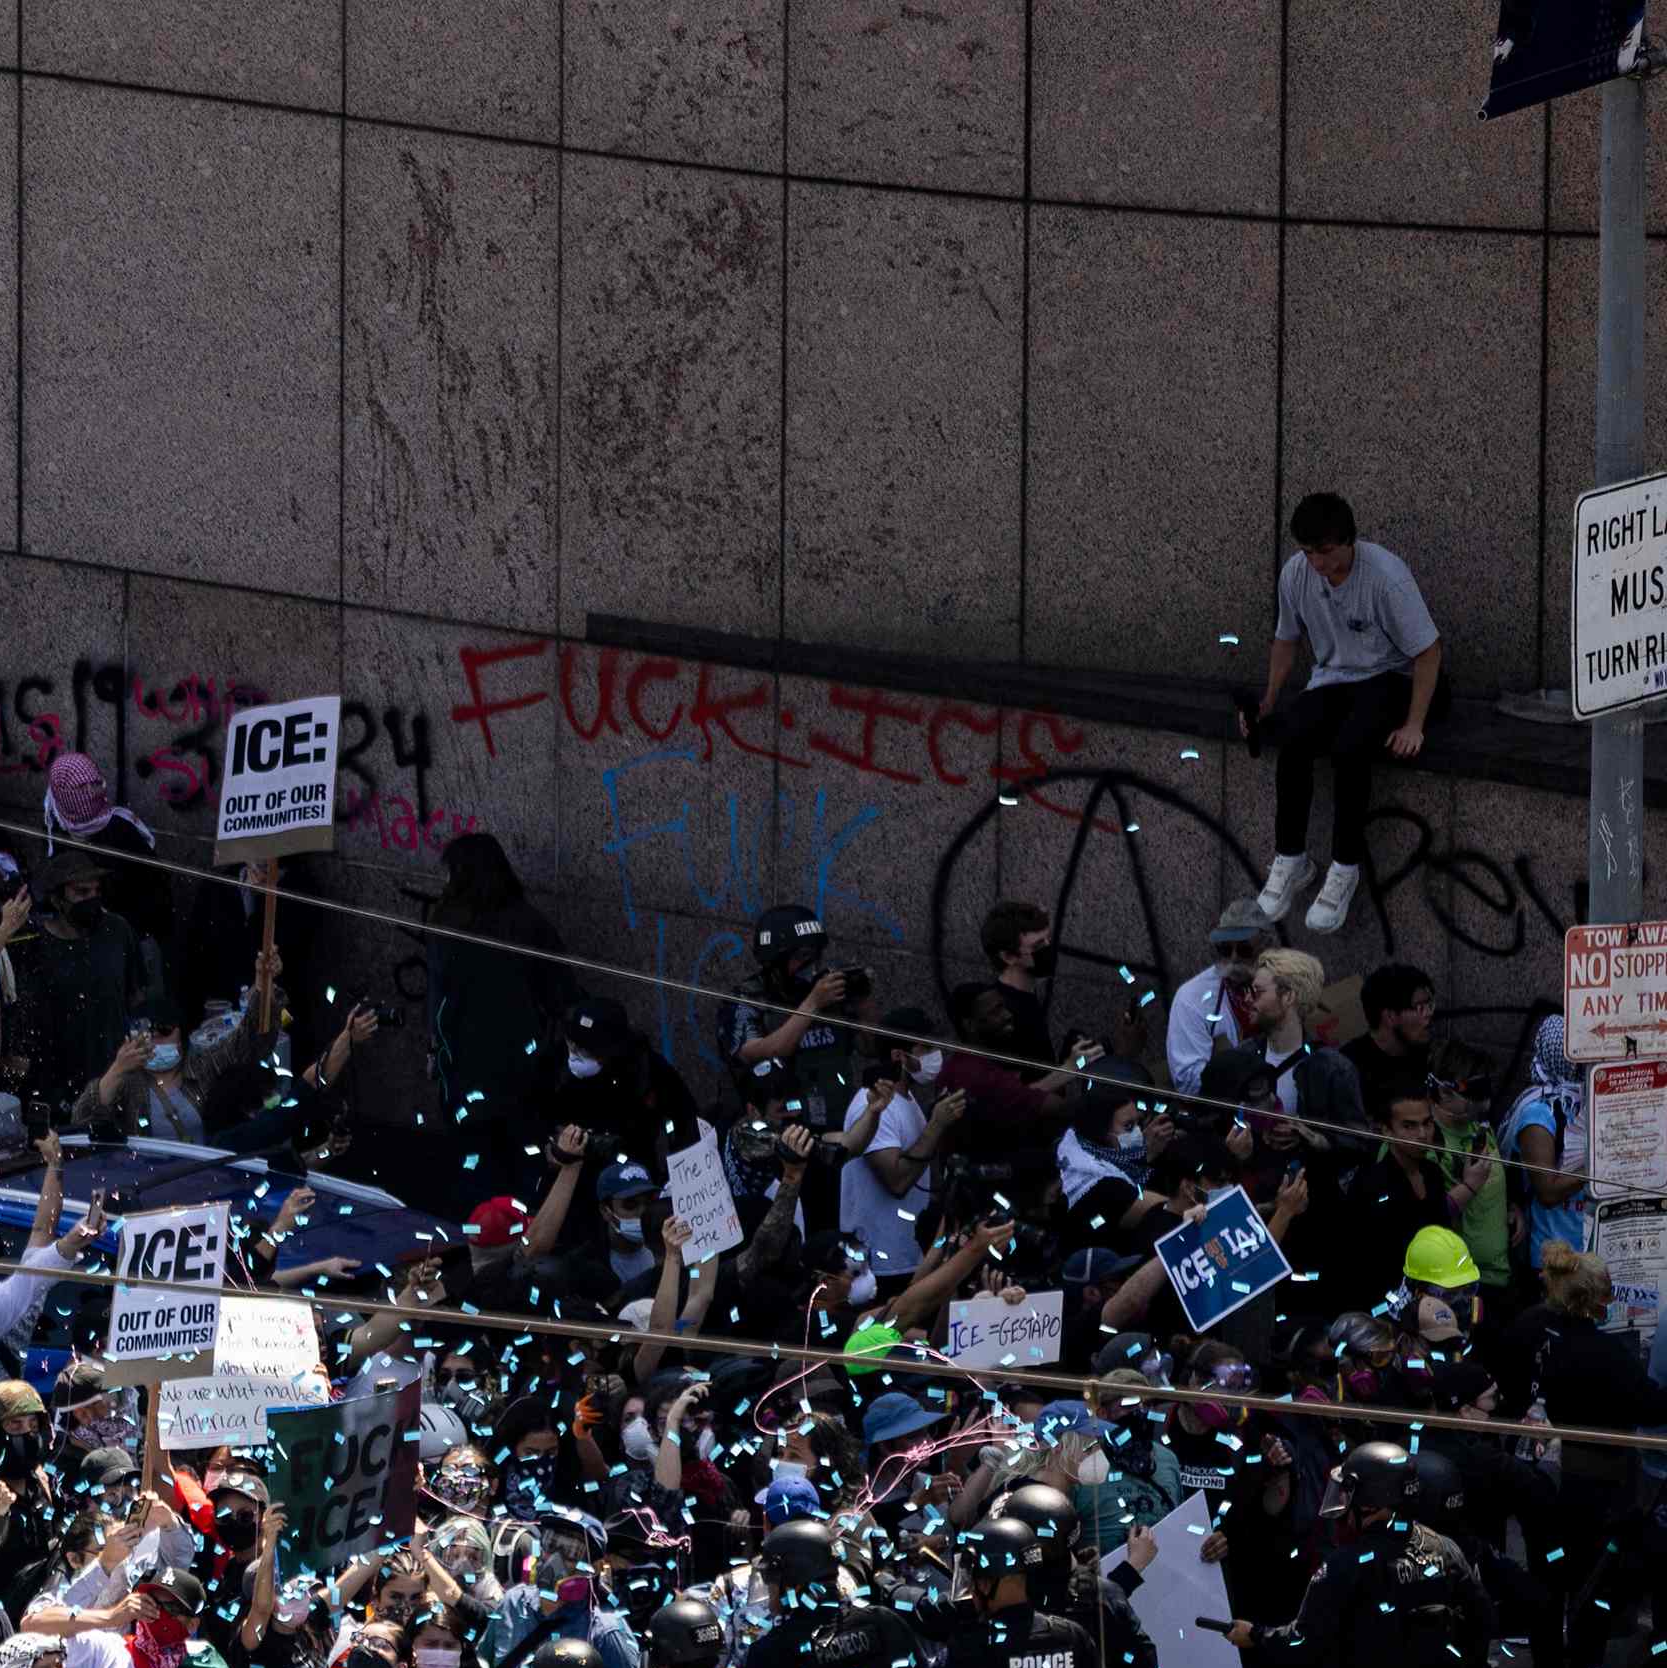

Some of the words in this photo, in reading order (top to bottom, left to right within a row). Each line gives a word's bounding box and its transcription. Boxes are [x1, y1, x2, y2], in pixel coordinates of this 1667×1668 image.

[1587, 511, 1647, 558] RIGHT
[1586, 643, 1643, 685] TURN
[232, 711, 329, 777] ICE:
[224, 794, 262, 816] OUT
[265, 789, 288, 809] OF
[290, 782, 328, 804] OUR
[223, 804, 327, 834] COMMUNITIES!
[1586, 925, 1630, 949] TOW
[1570, 952, 1609, 988] NO
[1582, 994, 1624, 1018] ANY
[128, 1222, 218, 1283] ICE:
[117, 1312, 150, 1334] OUT
[154, 1307, 177, 1328] OF
[180, 1302, 216, 1326] OUR
[115, 1327, 214, 1354] COMMUNITIES!
[950, 1321, 986, 1358] ICE
